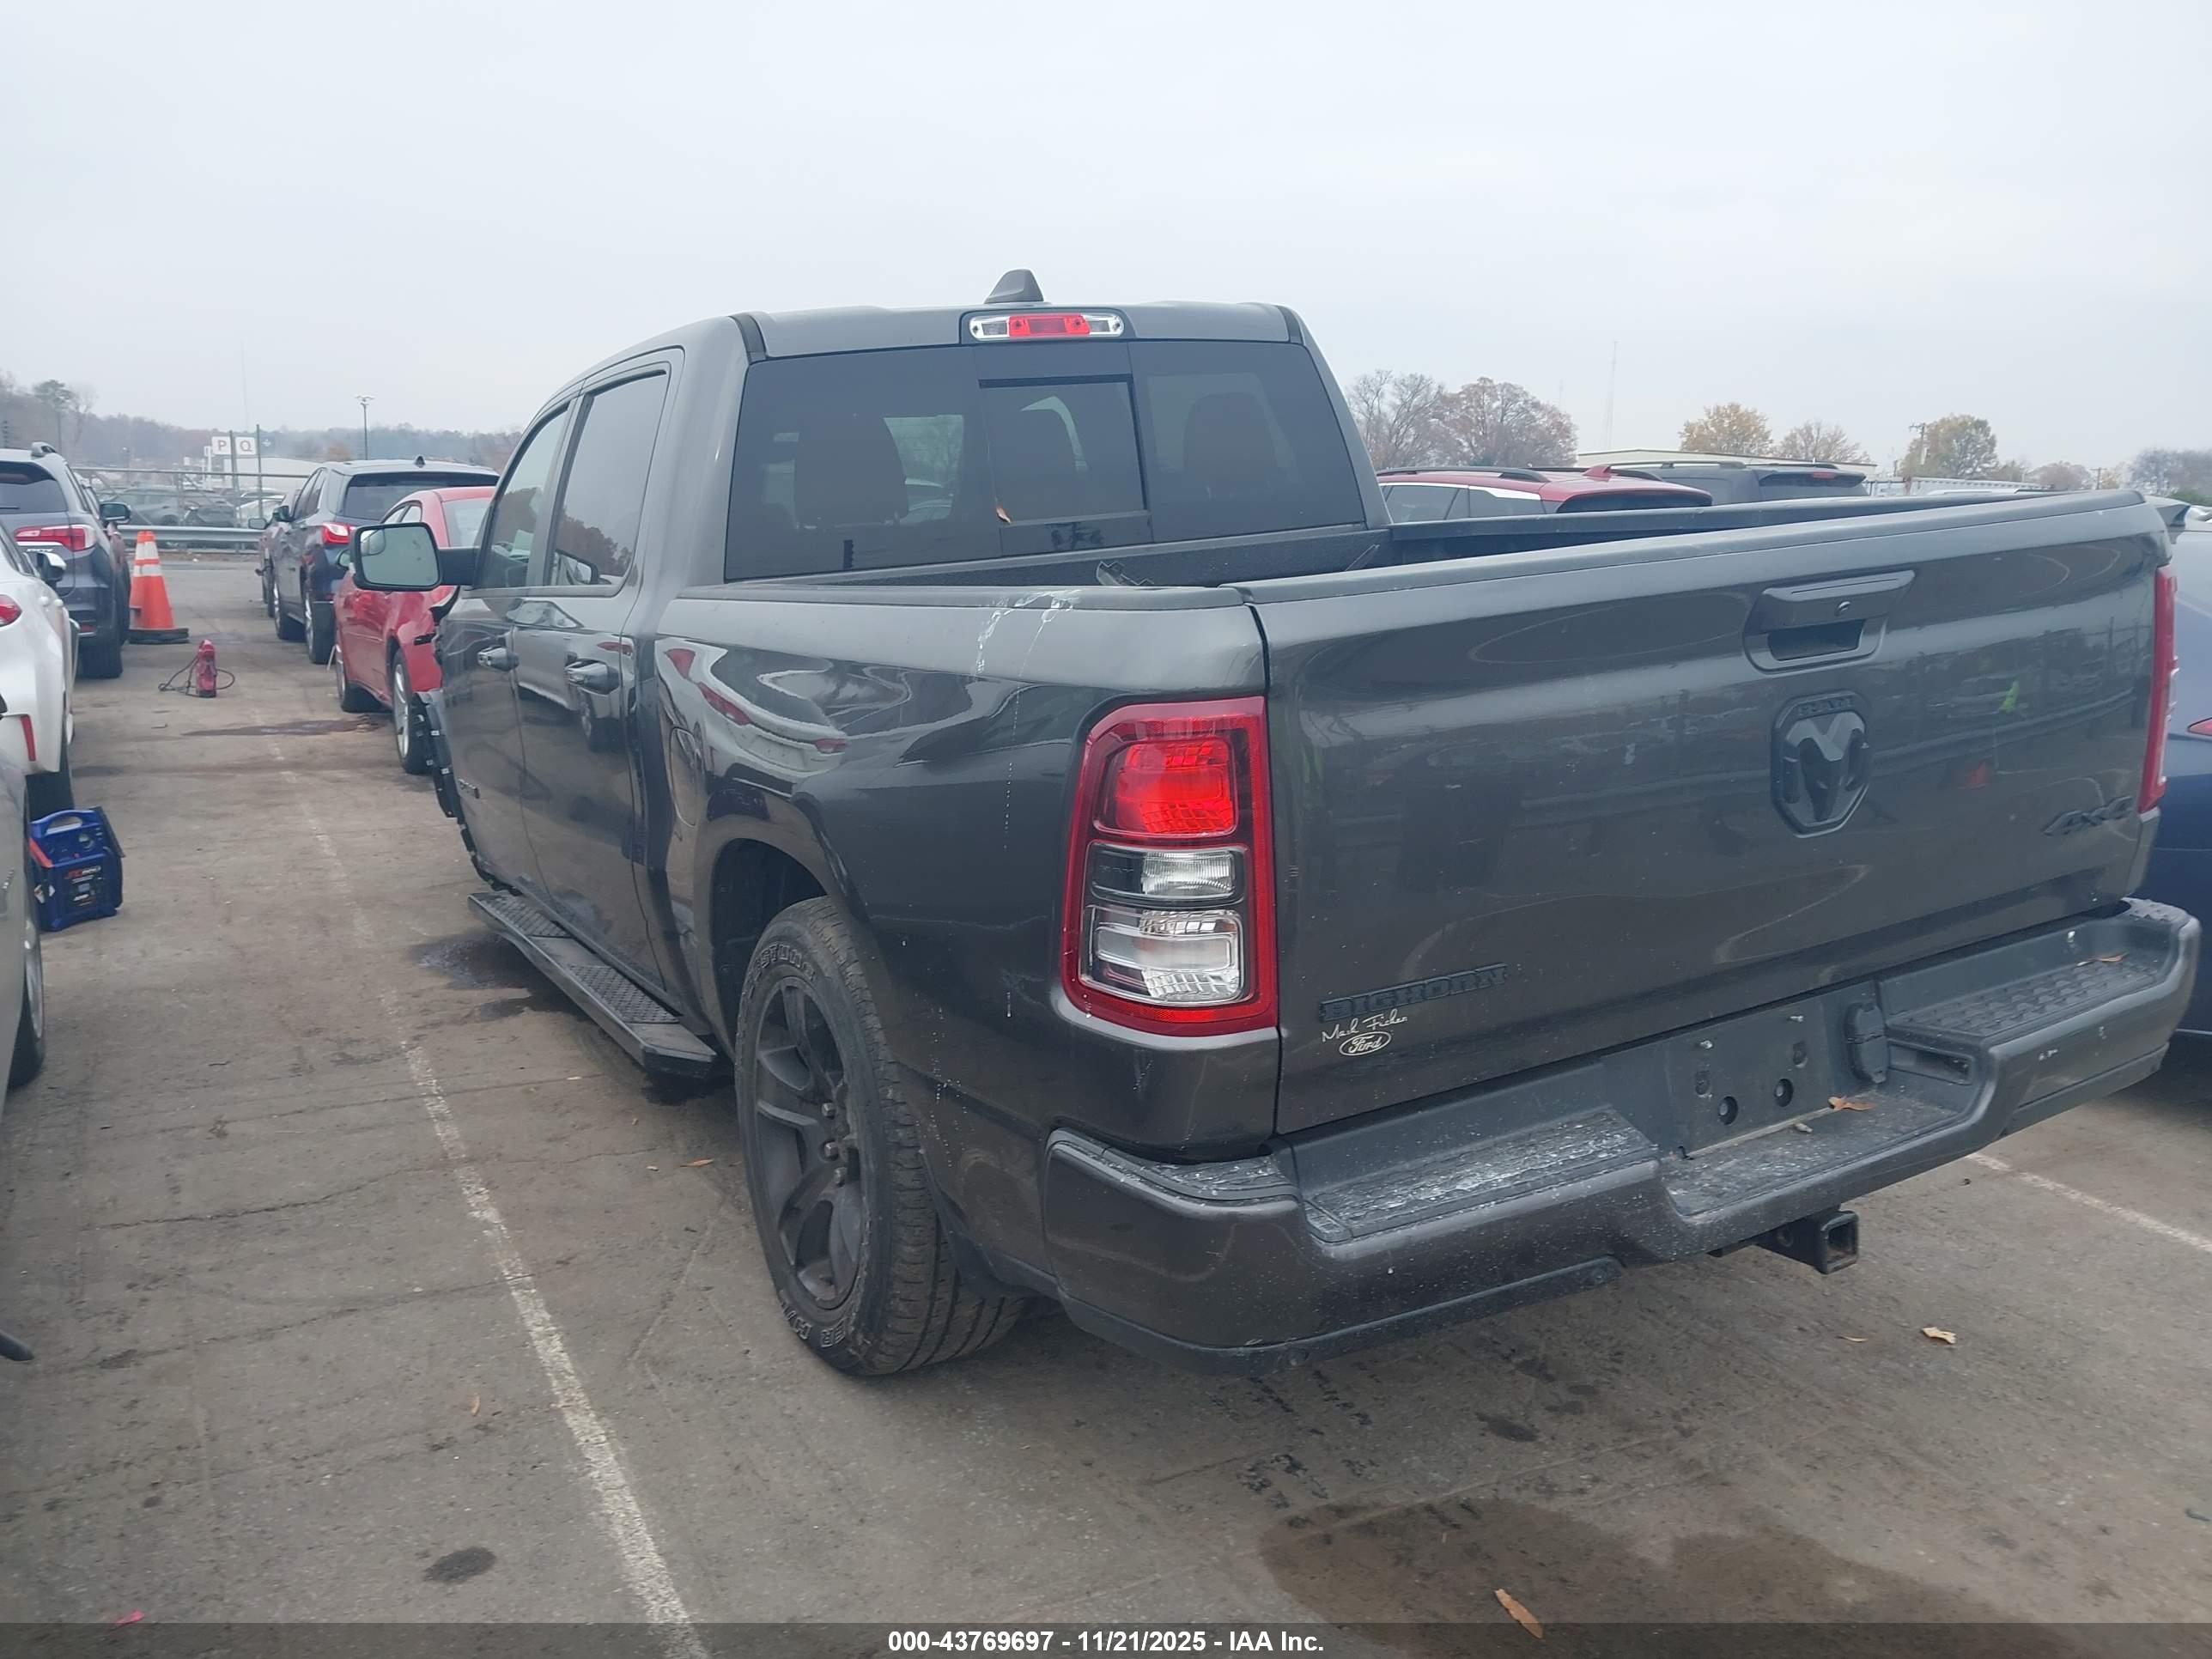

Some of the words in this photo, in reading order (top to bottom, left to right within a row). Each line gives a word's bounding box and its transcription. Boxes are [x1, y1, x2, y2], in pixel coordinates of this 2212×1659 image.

[217, 440, 227, 452] P
[240, 440, 252, 453] Q
[1347, 1034, 1384, 1054] Ford
